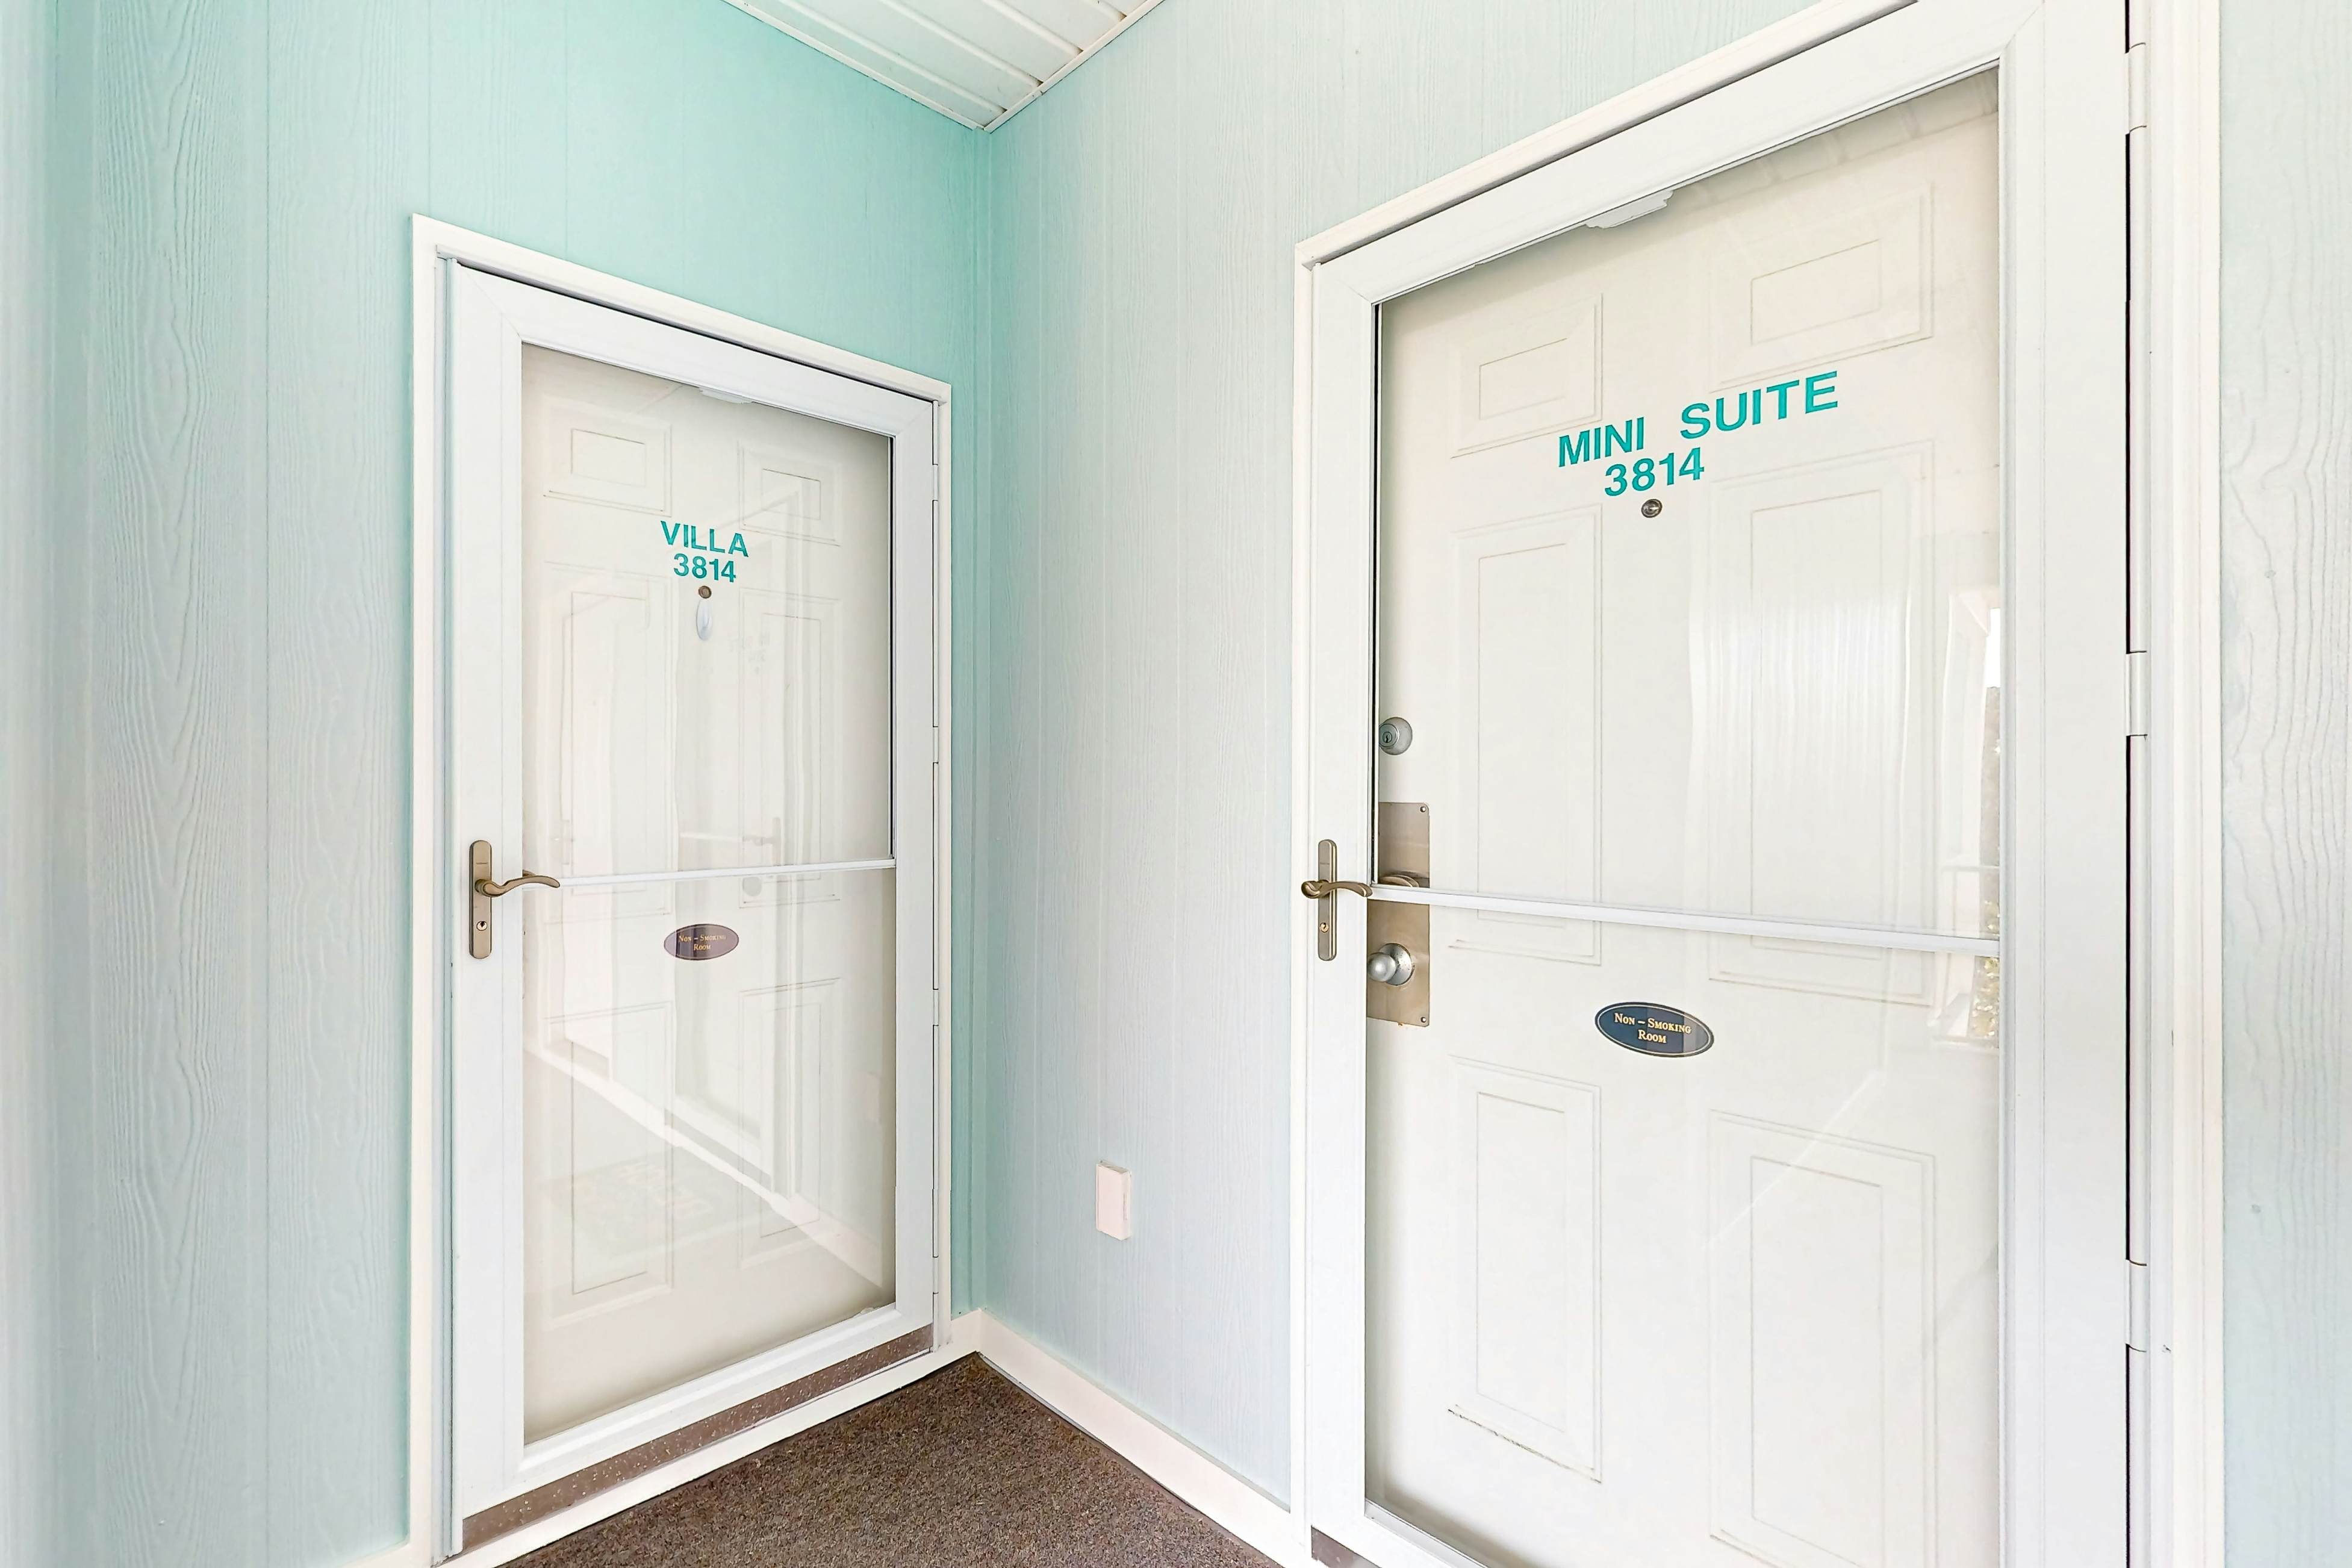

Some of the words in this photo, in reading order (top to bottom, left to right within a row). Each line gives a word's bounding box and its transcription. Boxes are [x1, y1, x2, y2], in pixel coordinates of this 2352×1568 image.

[1558, 417, 1644, 467] MINI
[1680, 370, 1838, 440] SUITE
[1604, 447, 1705, 497] 3814
[660, 520, 748, 557] VILLA
[673, 553, 736, 583] 3814
[1614, 1013, 1635, 1025] NON
[1647, 1018, 1691, 1034] SMOKING
[1638, 1030, 1667, 1044] ROOM
